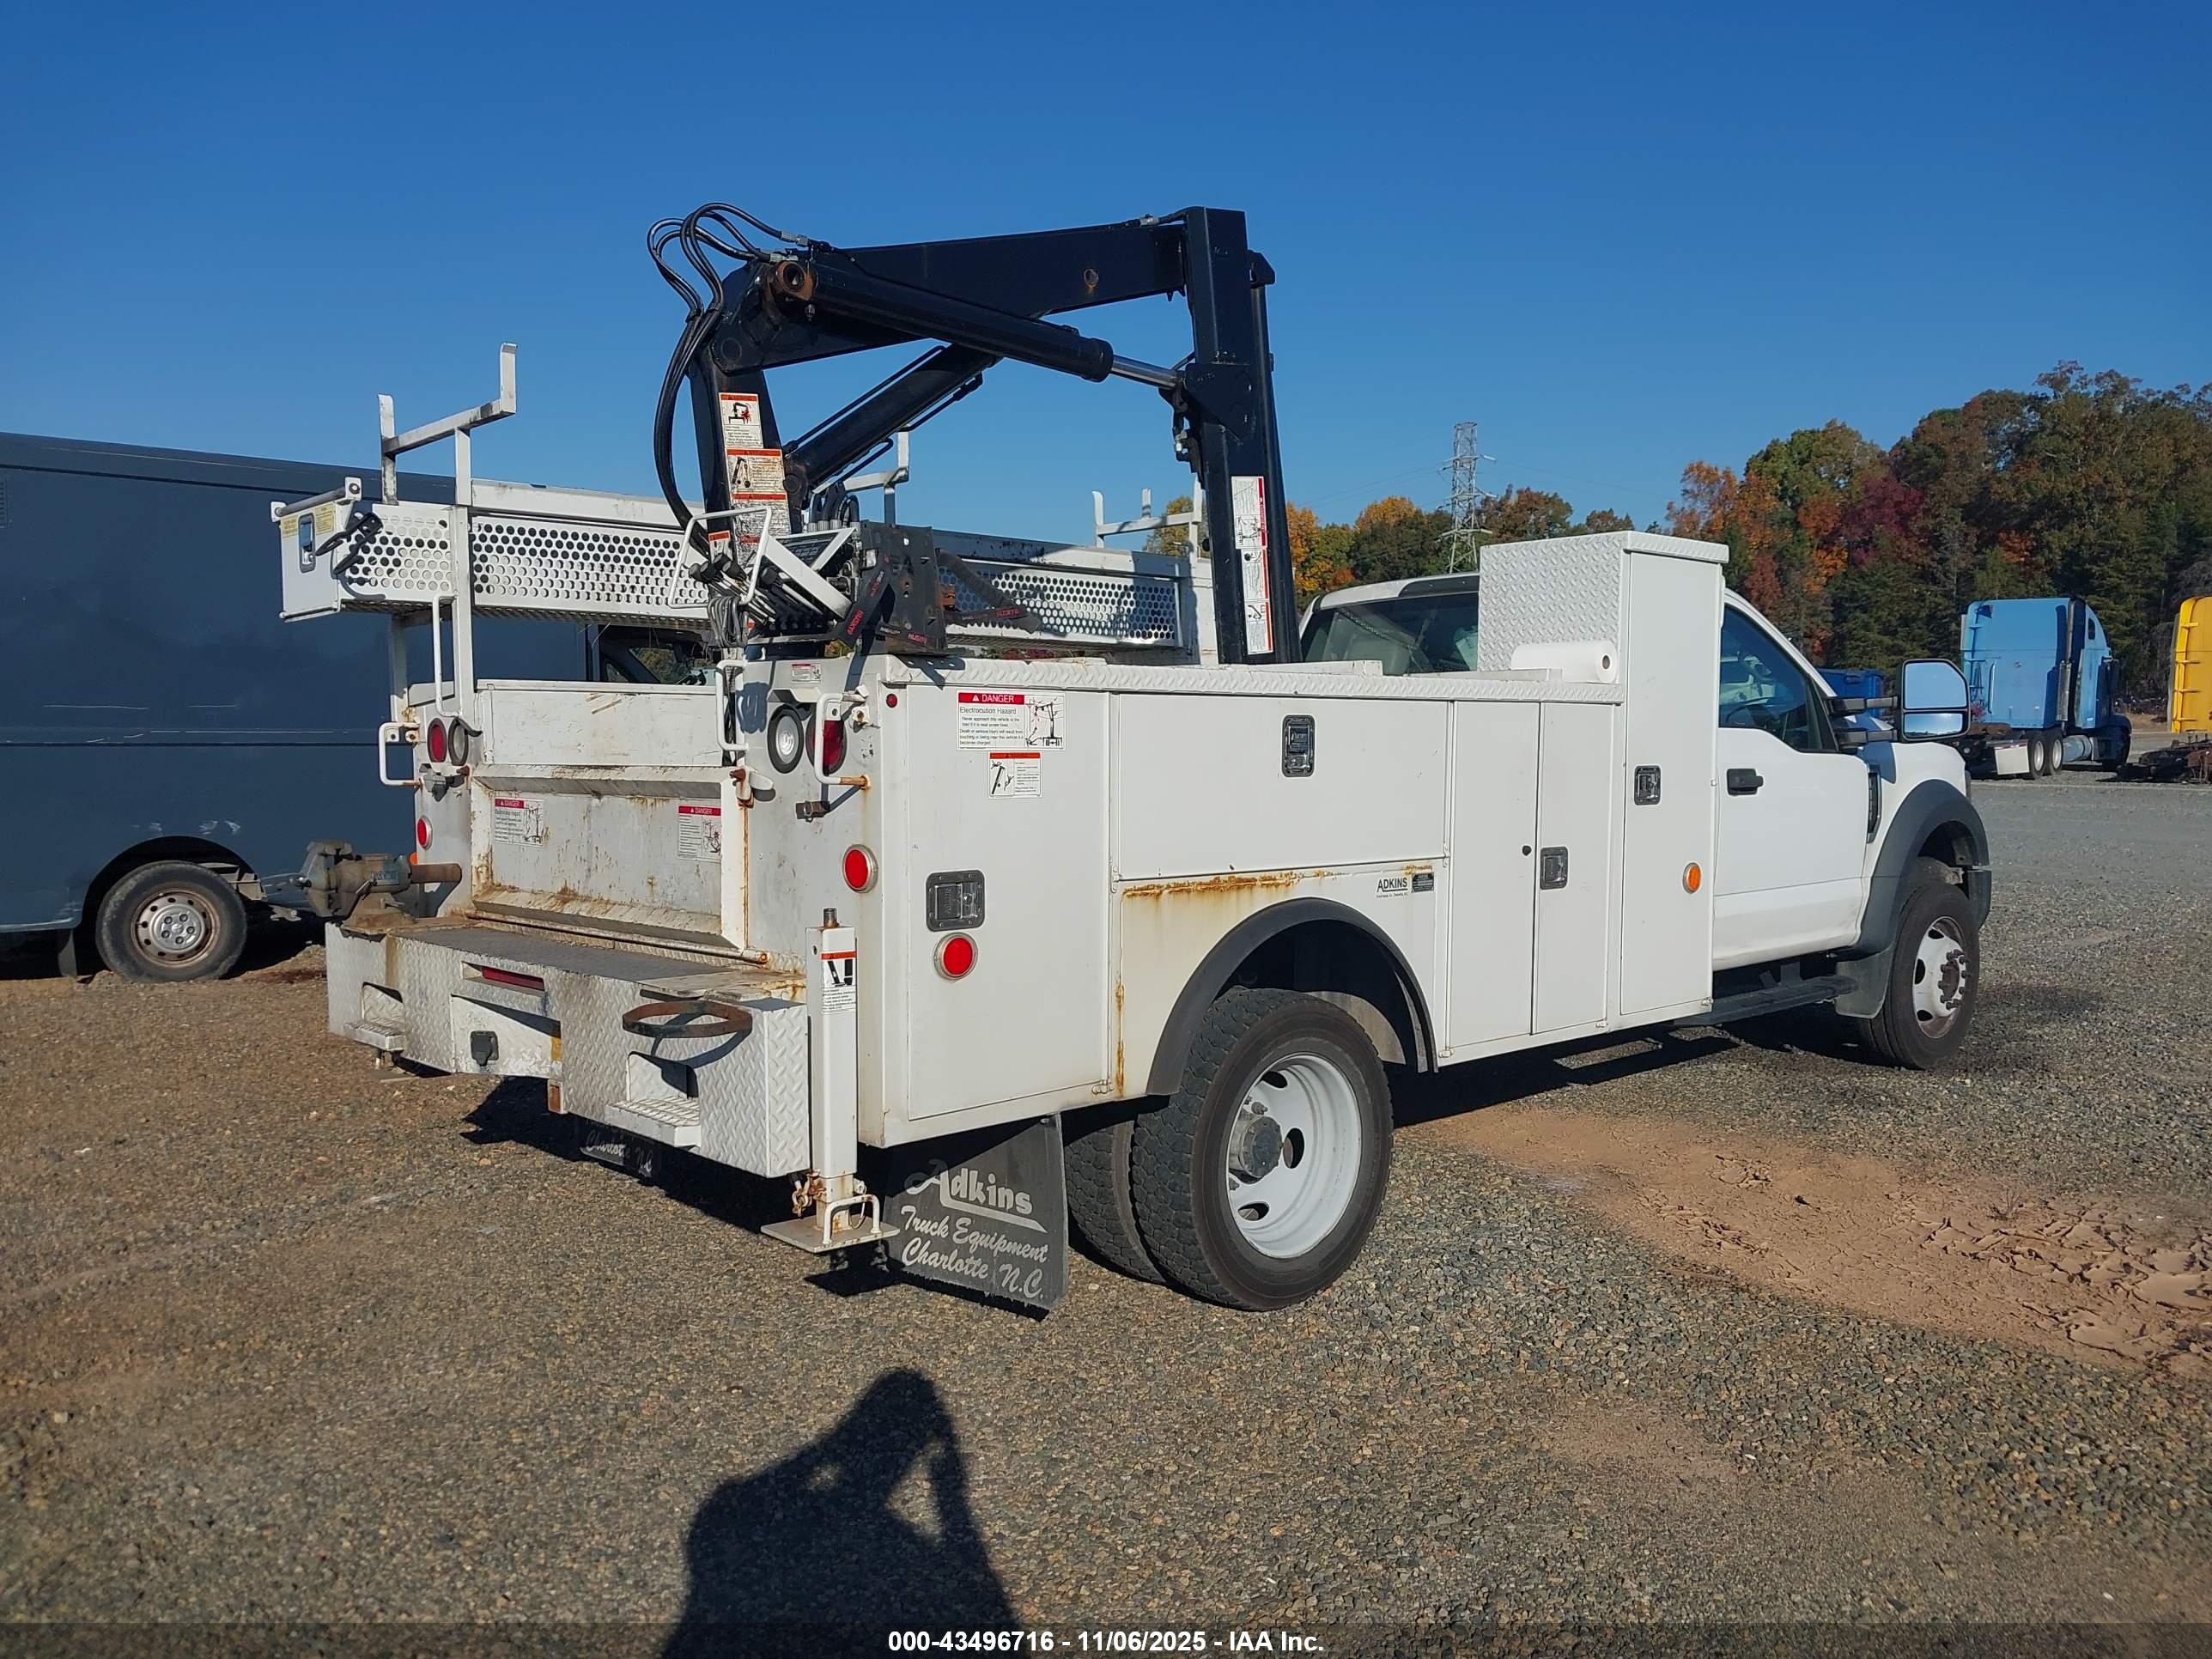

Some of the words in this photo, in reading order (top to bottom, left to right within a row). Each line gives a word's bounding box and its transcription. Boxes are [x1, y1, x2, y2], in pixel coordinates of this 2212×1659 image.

[981, 694, 1014, 702] DANGER
[1376, 877, 1407, 893] ADKINS
[904, 1158, 1033, 1215] Adkins
[900, 1205, 949, 1239] Truck
[952, 1218, 1048, 1262] Equipment
[902, 1237, 989, 1279] Charlotte
[999, 1263, 1044, 1299] N.C.
